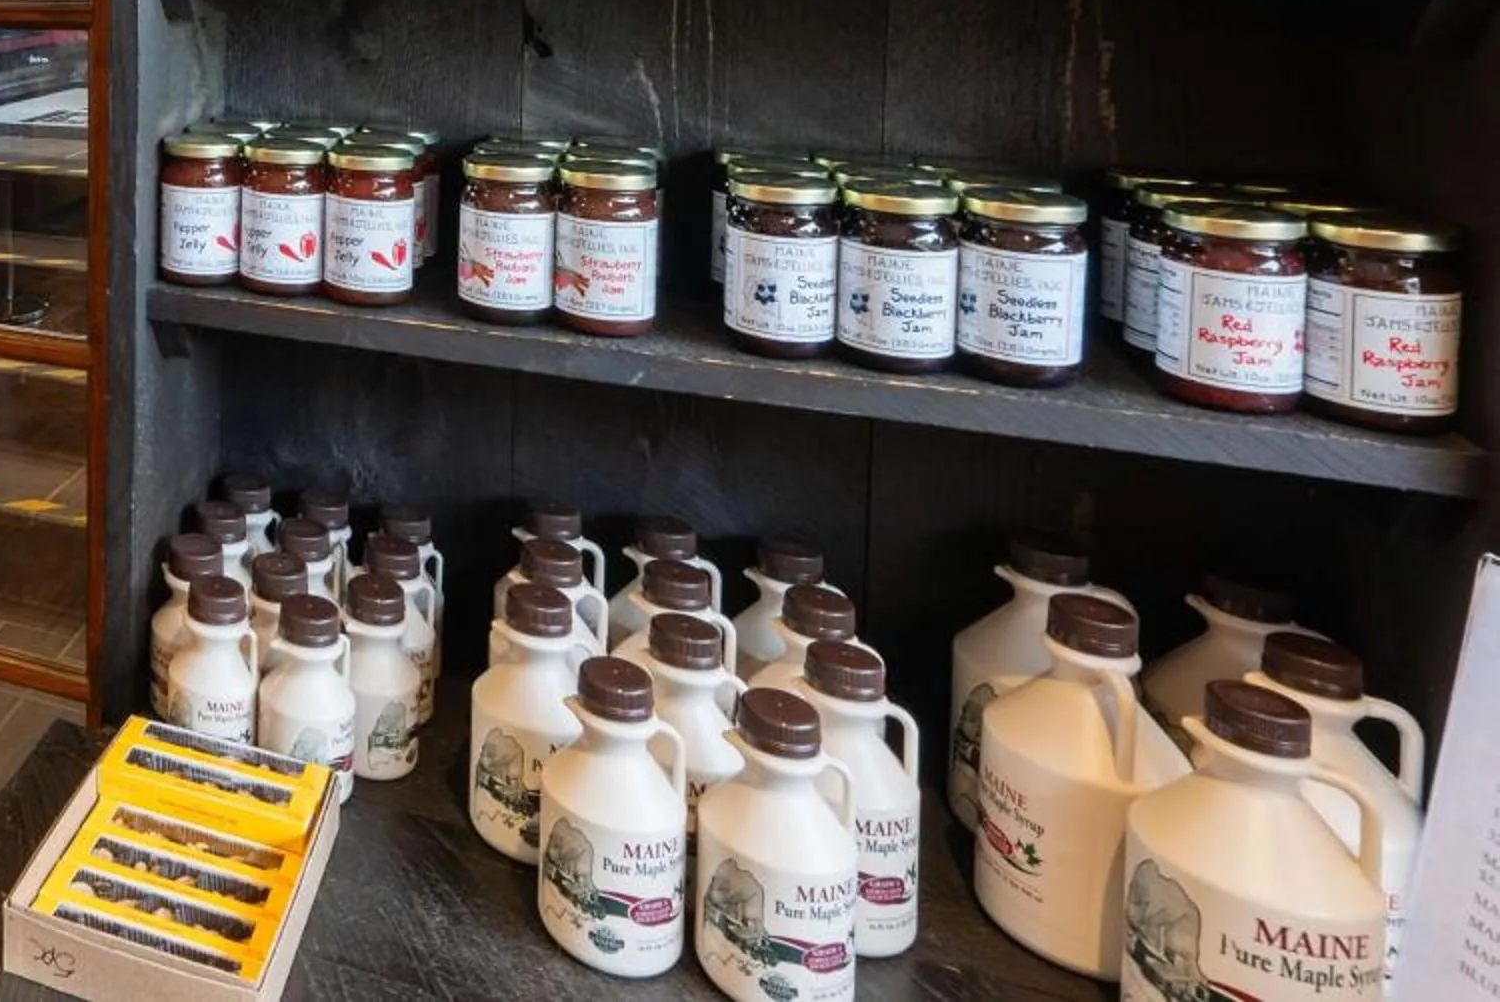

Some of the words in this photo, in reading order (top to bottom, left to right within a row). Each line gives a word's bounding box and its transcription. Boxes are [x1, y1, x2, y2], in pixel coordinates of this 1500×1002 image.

[173, 220, 210, 236] Pepper
[180, 238, 207, 254] Jelly
[485, 246, 543, 261] Strawberry
[580, 254, 643, 272] Strawberry
[867, 255, 915, 271] MAINE
[505, 273, 527, 286] Jam
[591, 269, 635, 283] Rhubarb
[602, 283, 626, 296] Jam
[890, 287, 943, 304] Seedless
[996, 289, 1058, 310] Seedless
[806, 306, 829, 319] Jam
[882, 301, 948, 319] Blackberry
[988, 303, 1063, 328] Blackberry
[901, 319, 933, 334] Jam
[1008, 324, 1044, 340] Jam
[1221, 313, 1253, 333] Red
[1196, 327, 1284, 356] Raspberry
[1388, 336, 1422, 355] Red
[1232, 351, 1273, 366] Jam
[1362, 349, 1450, 376] Raspberry
[1400, 373, 1445, 389] Jam
[205, 699, 246, 713] MAINE
[983, 764, 1028, 811] MAINE
[855, 816, 912, 837] MAINE
[1014, 807, 1046, 839] Syrup
[866, 837, 899, 858] Maple
[602, 855, 632, 876] Pure
[634, 858, 668, 879] Maple
[774, 899, 806, 919] Pure
[1254, 916, 1372, 961] MAINE
[1219, 931, 1273, 974] Pure
[1279, 953, 1345, 995] Maple
